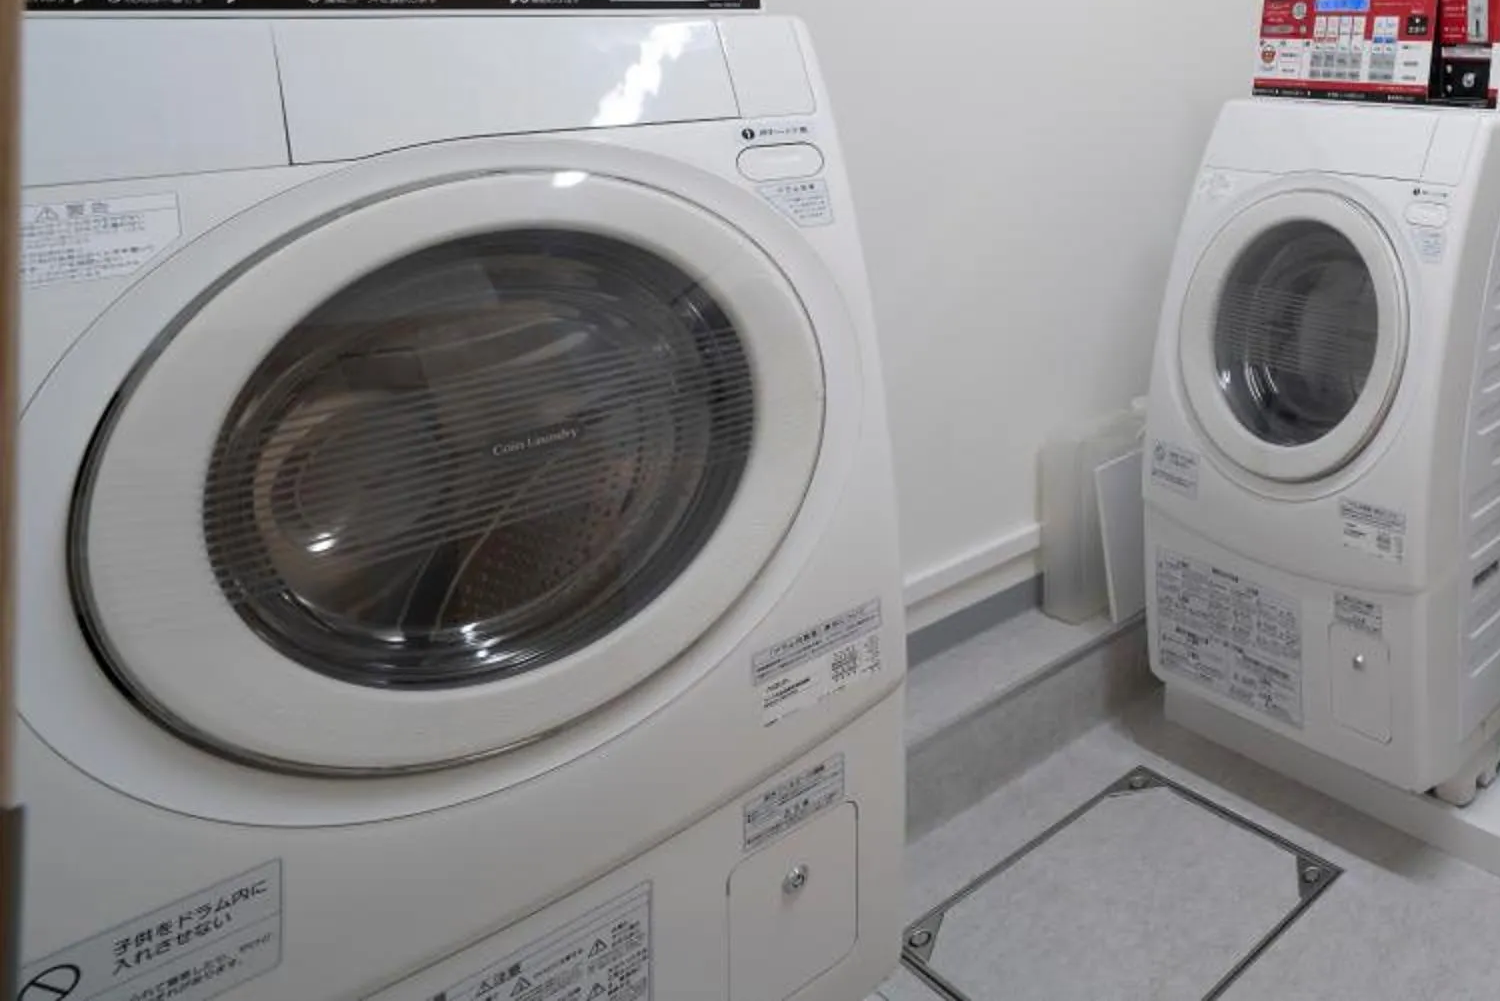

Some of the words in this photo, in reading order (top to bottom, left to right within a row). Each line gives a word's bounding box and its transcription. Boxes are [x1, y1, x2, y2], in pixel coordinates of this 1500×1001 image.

[112, 912, 234, 976] 入れさせない
